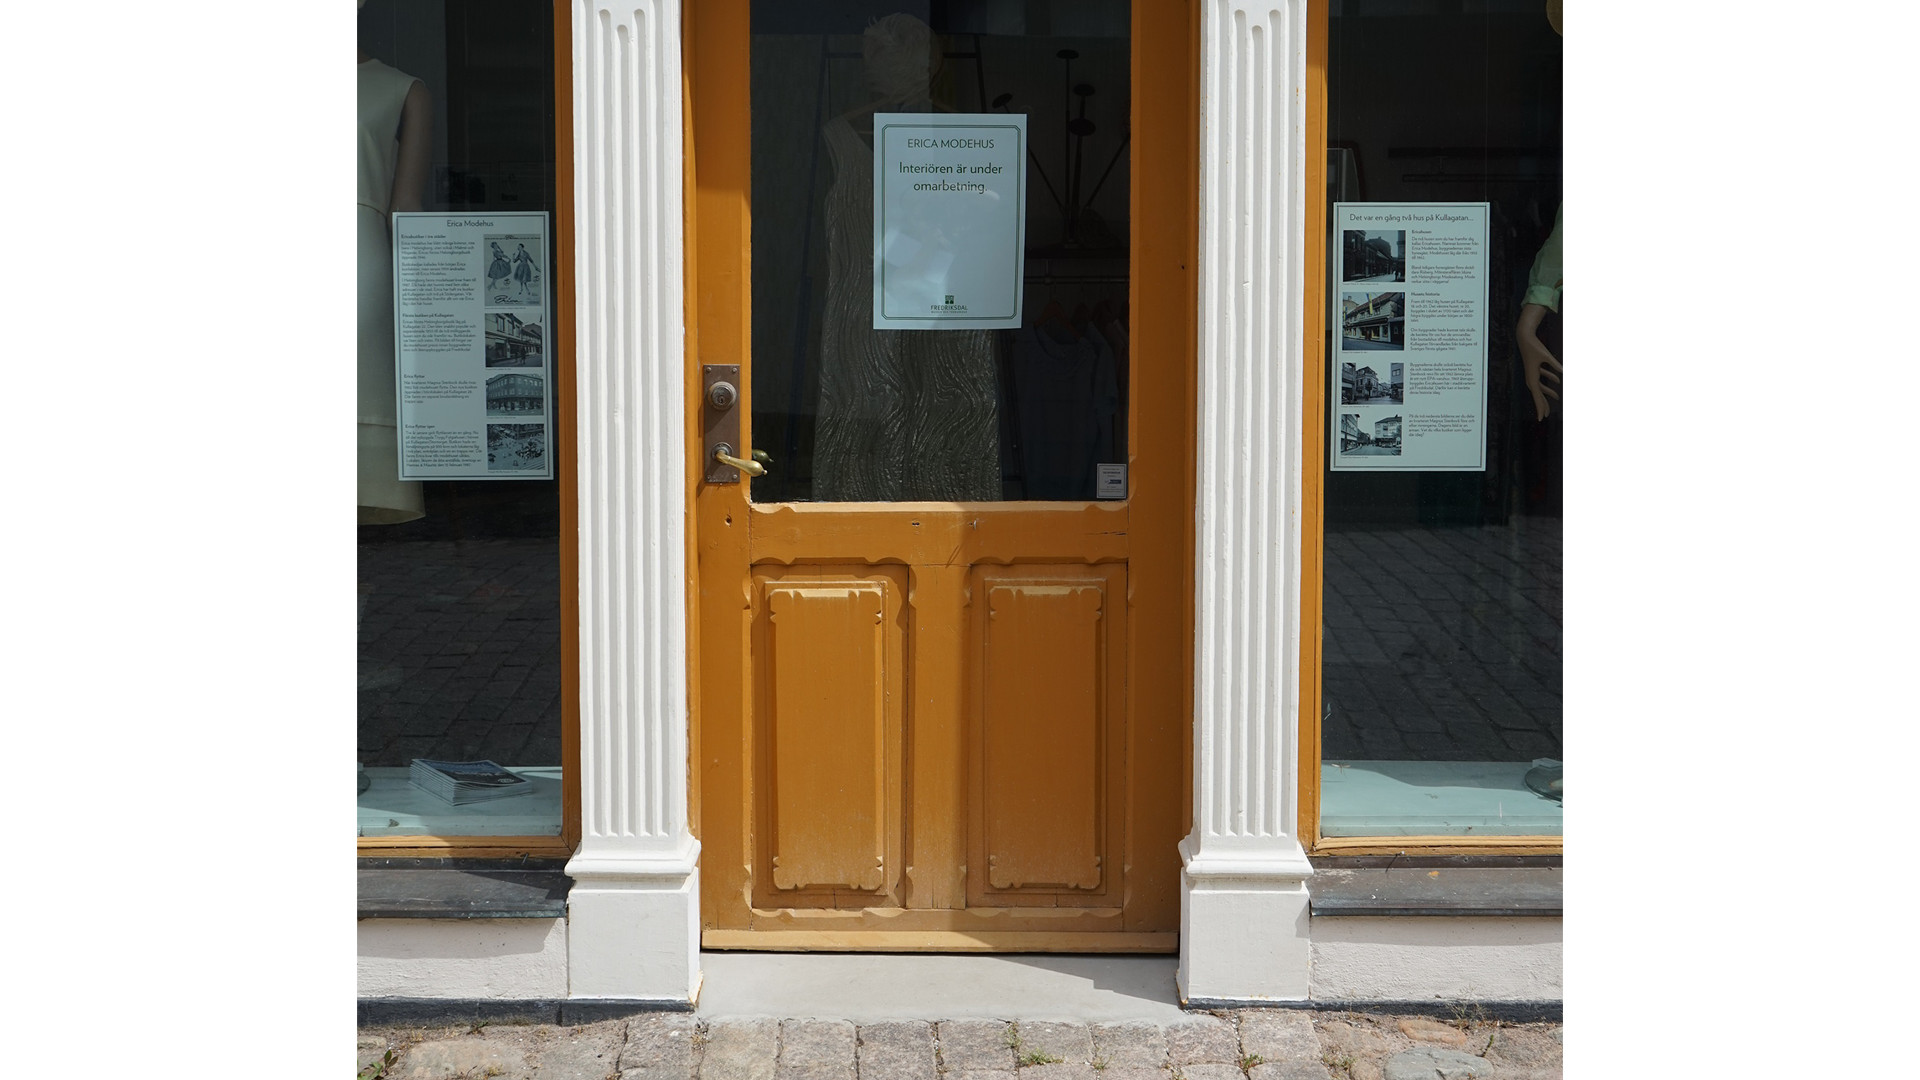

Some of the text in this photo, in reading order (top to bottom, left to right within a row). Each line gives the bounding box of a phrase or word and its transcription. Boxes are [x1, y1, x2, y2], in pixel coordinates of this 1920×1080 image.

[908, 139, 994, 148] ERICA MODEHUS
[900, 162, 1002, 174] Interiören är under
[914, 180, 988, 194] omarbetning.
[1384, 214, 1400, 222] gång
[1426, 214, 1433, 222] på
